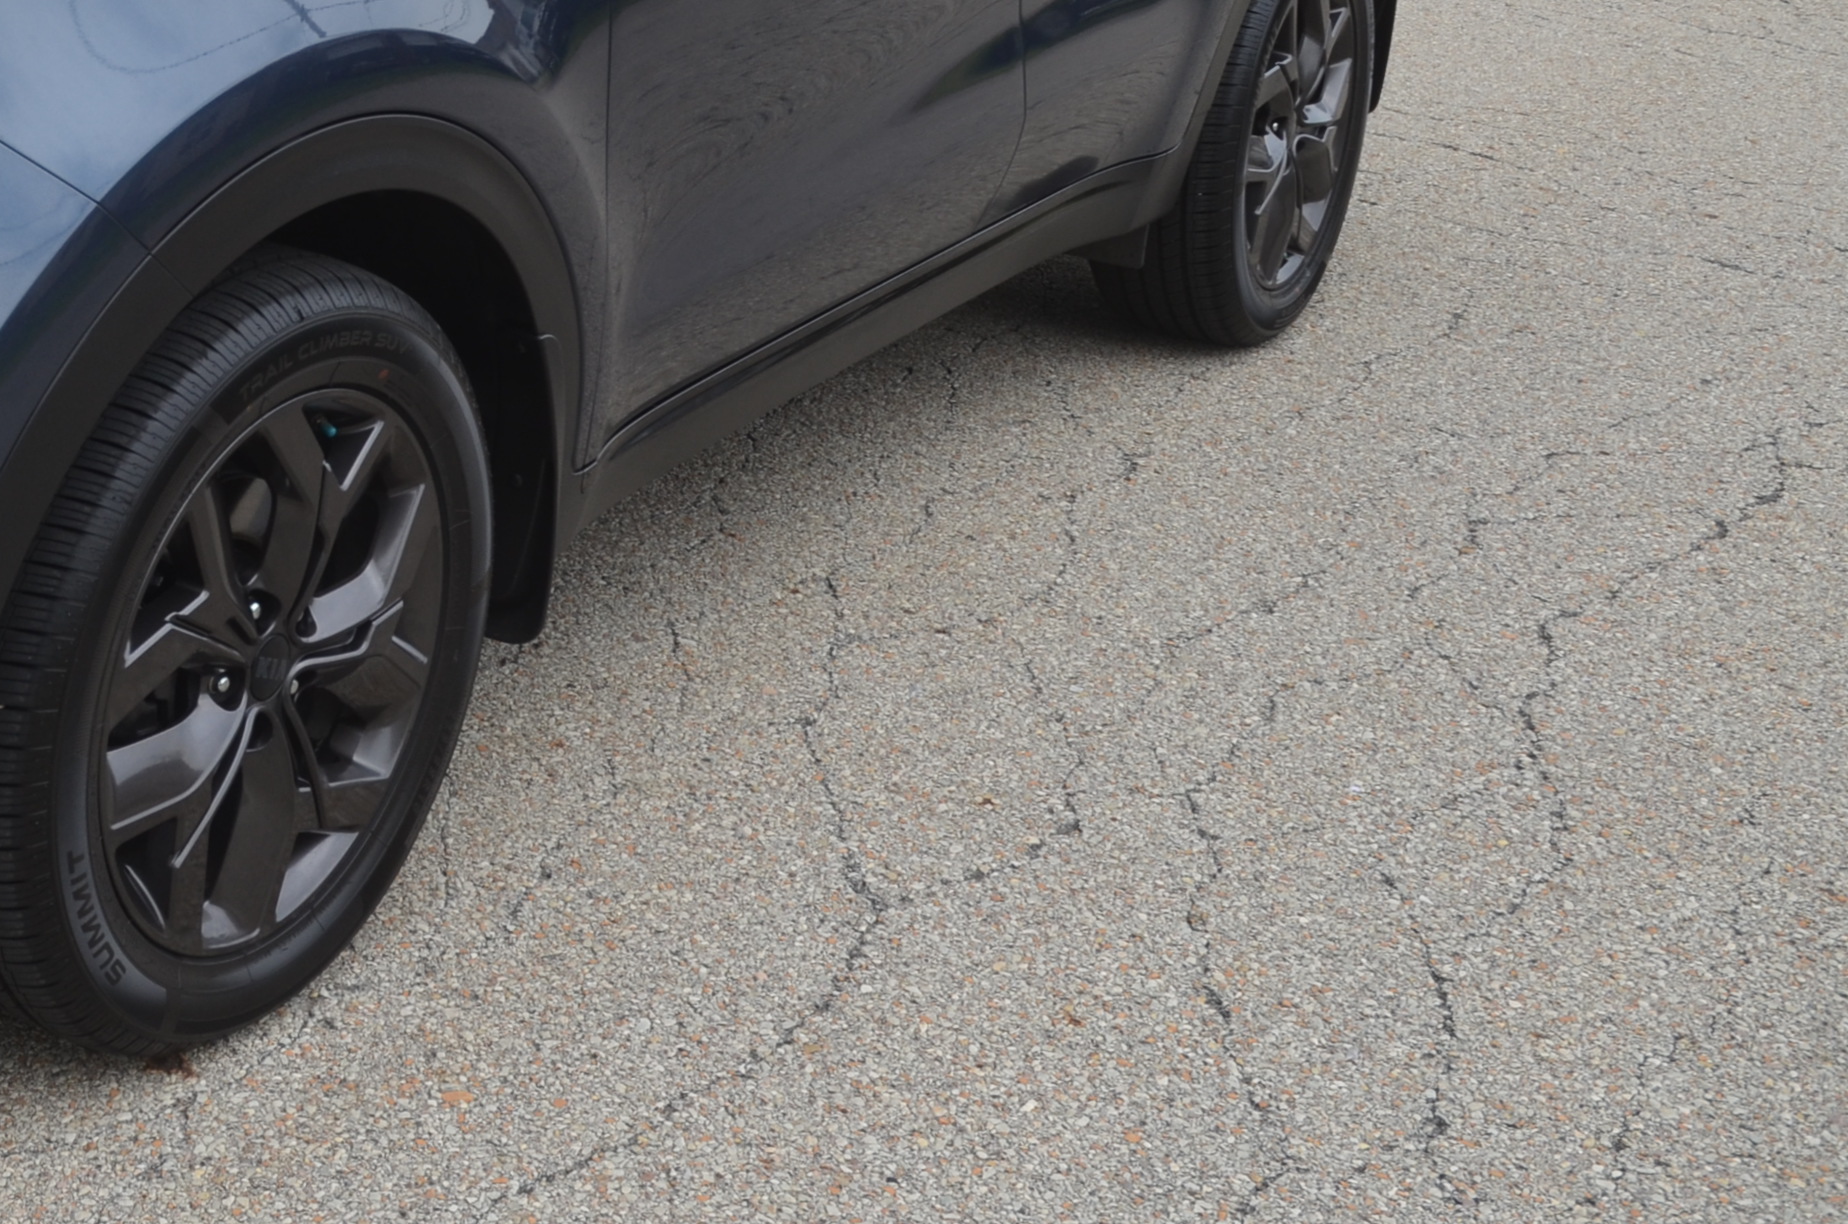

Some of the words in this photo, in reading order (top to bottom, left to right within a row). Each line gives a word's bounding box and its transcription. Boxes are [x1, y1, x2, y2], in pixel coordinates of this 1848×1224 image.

[239, 355, 295, 402] TRAIL
[298, 330, 373, 360] CLIMBER
[374, 333, 411, 354] SUV
[255, 657, 287, 680] KIA
[66, 849, 126, 987] SUMMIT
